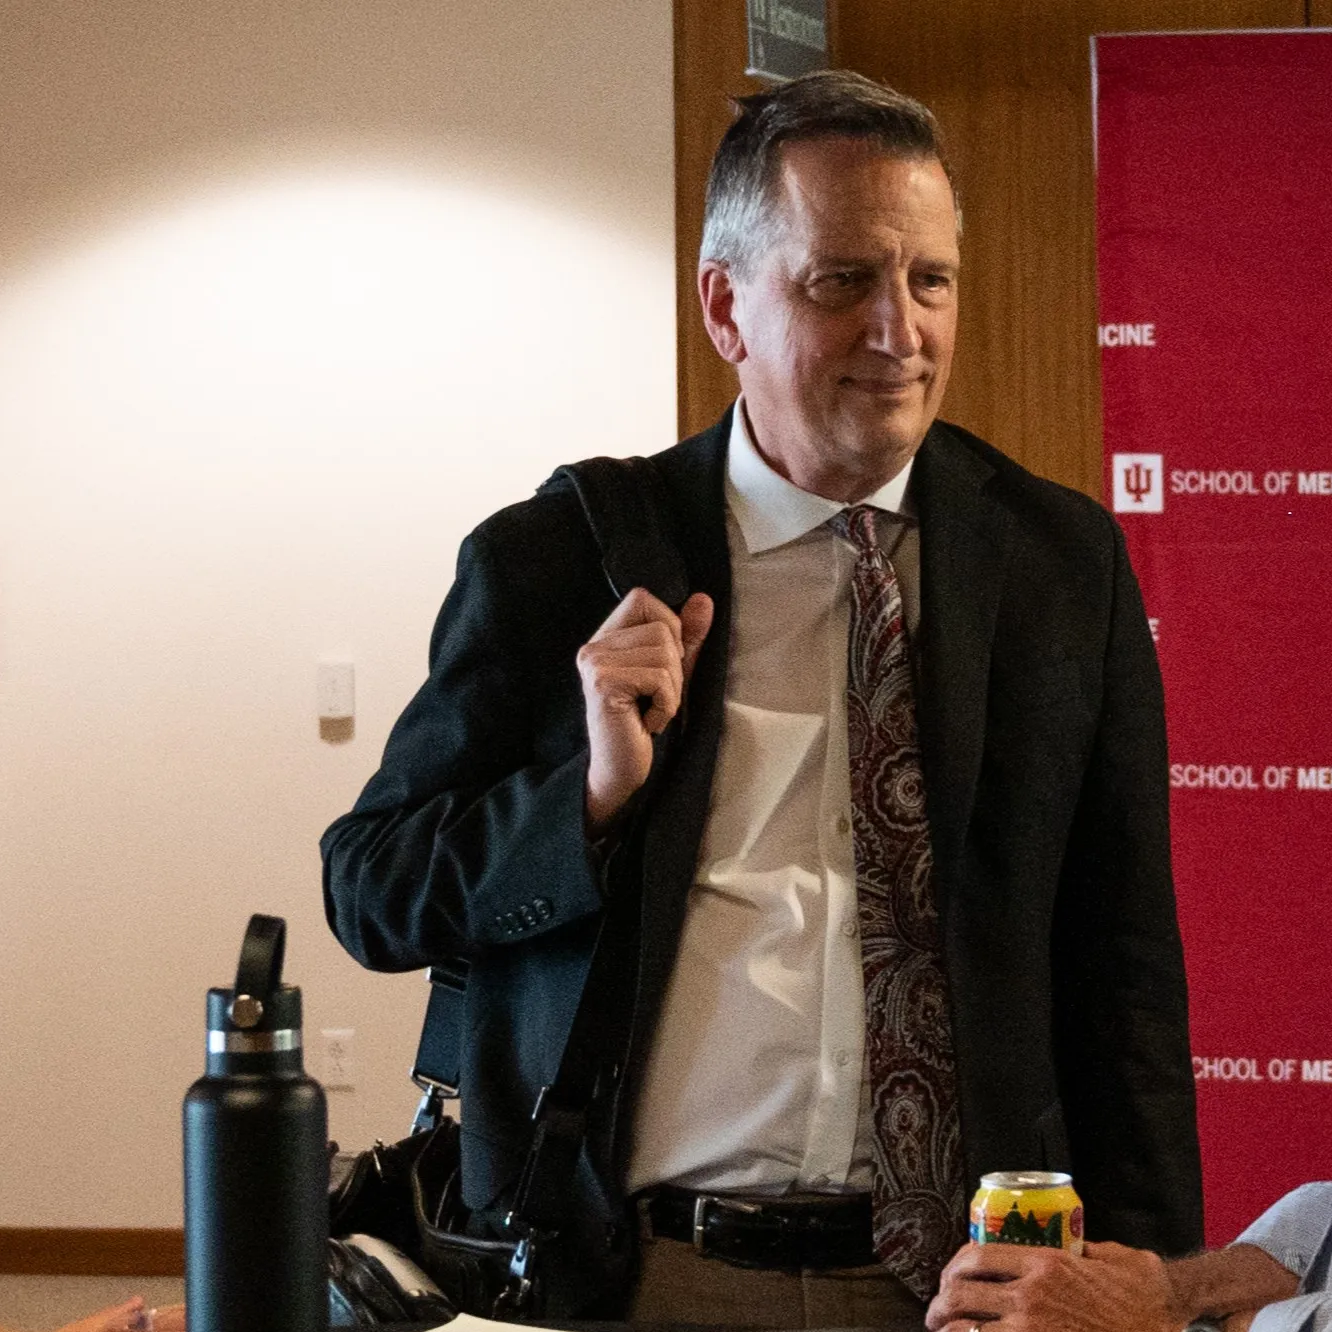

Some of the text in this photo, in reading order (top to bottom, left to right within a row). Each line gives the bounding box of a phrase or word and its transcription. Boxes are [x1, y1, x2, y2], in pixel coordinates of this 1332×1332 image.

[1097, 323, 1156, 347] ICINE
[1170, 469, 1260, 495] SCHOOL
[1263, 470, 1294, 495] OF
[1169, 764, 1259, 789] SCHOOL
[1262, 766, 1293, 790] OF
[1192, 1056, 1264, 1082] CHOOL
[1267, 1057, 1297, 1083] OF
